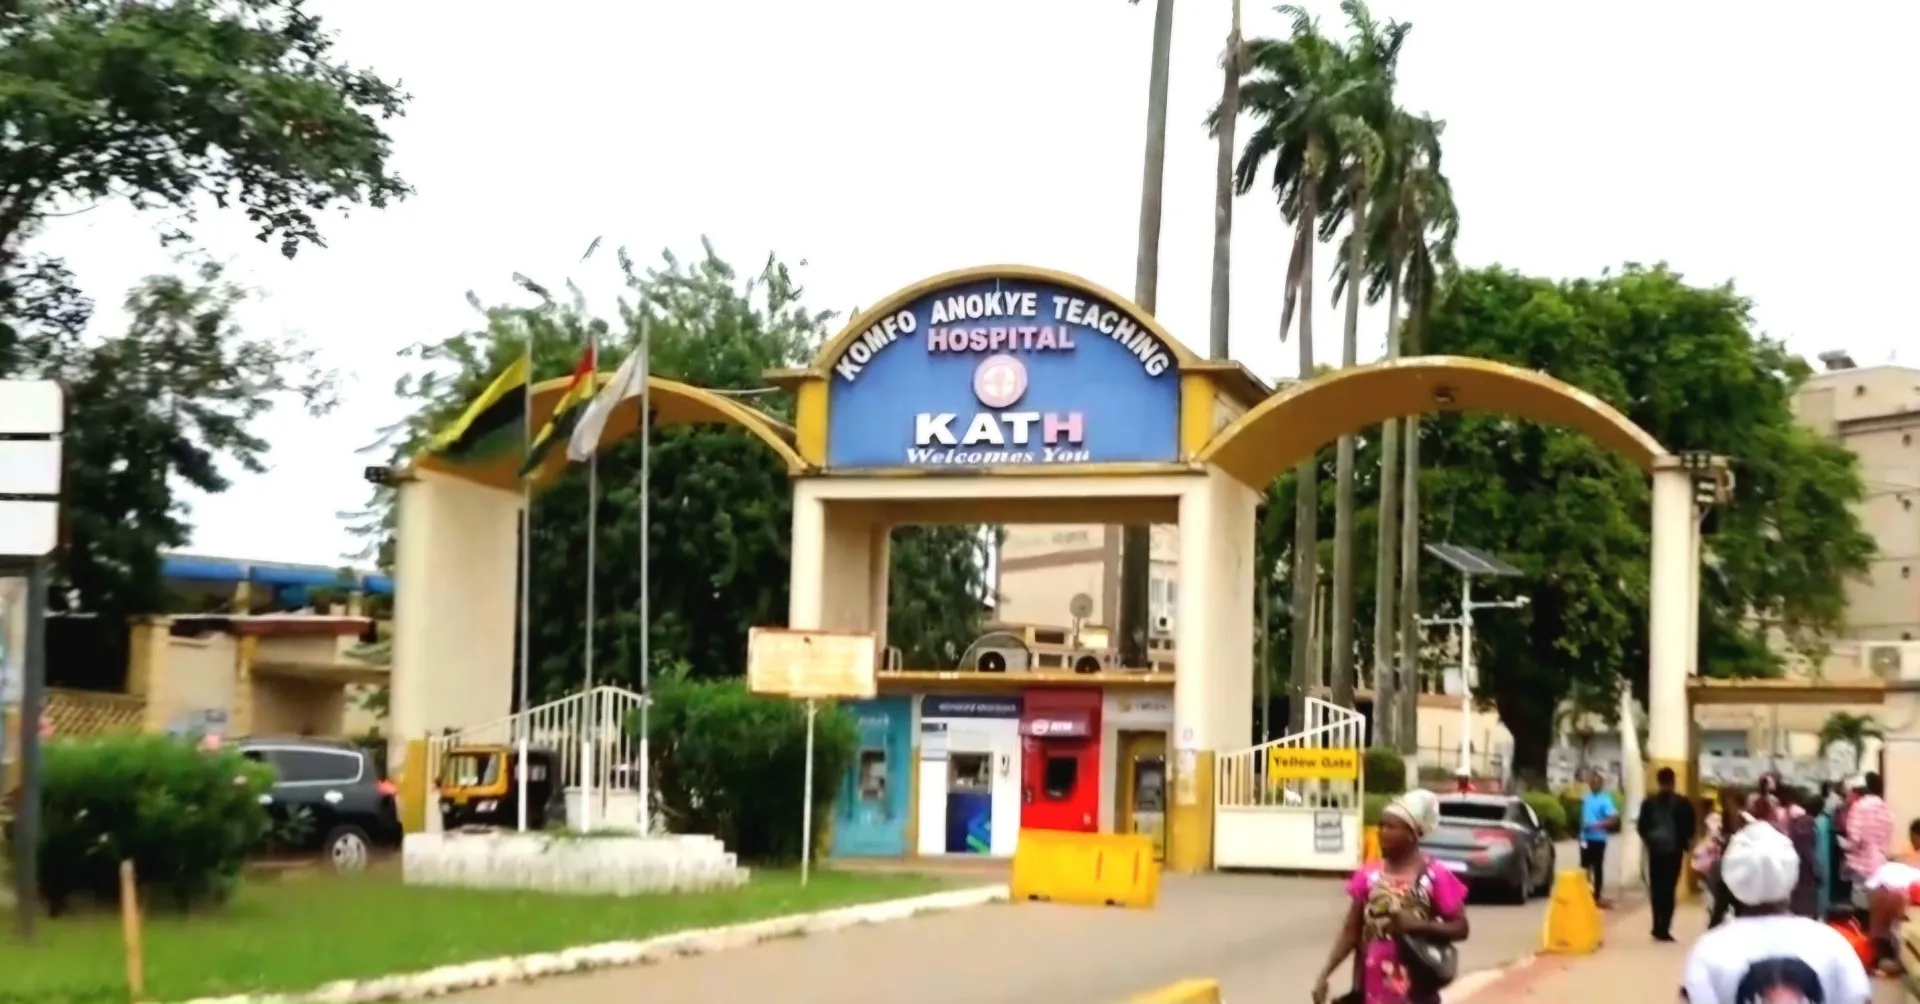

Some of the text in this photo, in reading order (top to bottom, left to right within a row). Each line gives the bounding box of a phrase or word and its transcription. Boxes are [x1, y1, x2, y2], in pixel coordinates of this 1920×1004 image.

[835, 291, 1170, 382] KOMFO ANOKYE TEACHING
[927, 326, 1075, 352] HOSPITAL
[915, 412, 1084, 446] KATH
[906, 446, 1090, 464] Welcomes You
[1273, 756, 1353, 769] Yellow Gate
